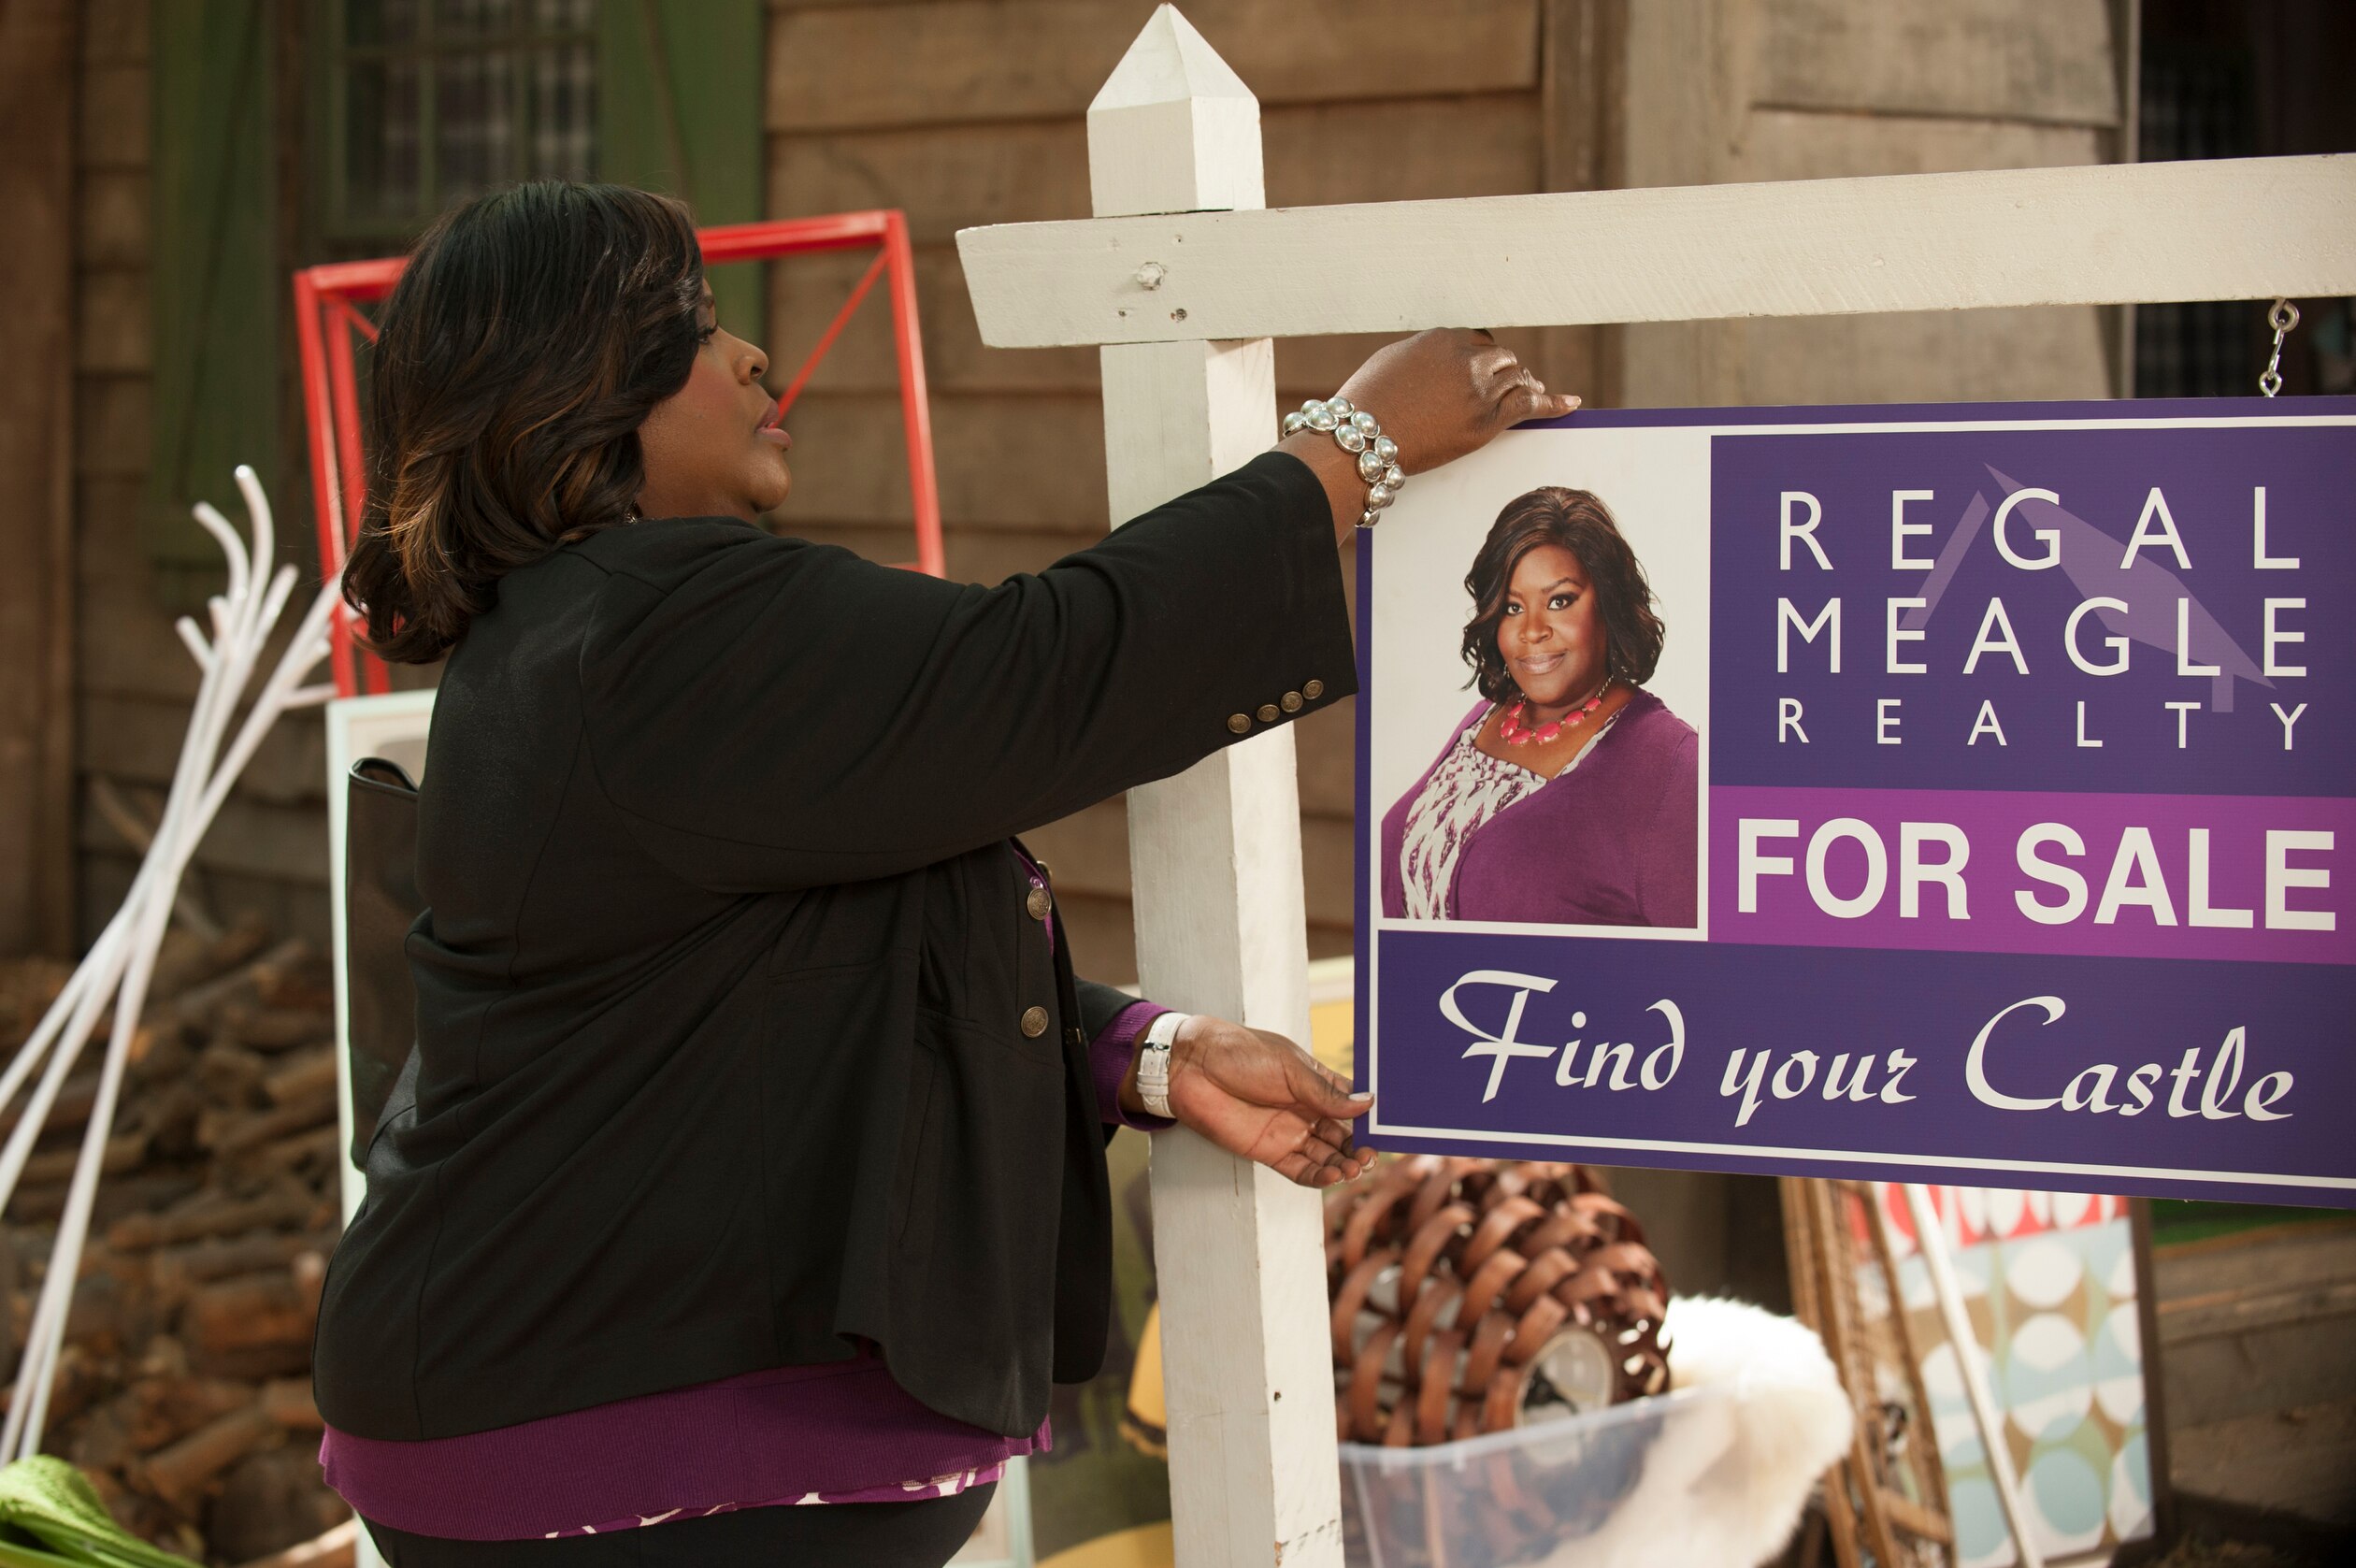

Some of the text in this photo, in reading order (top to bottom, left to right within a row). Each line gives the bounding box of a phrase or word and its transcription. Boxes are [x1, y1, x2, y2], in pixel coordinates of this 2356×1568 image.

[1780, 486, 2300, 570] REGAL
[1777, 596, 2307, 677] MEAGLE
[1778, 698, 2308, 751] REALTY
[1738, 817, 2336, 931] FOR SALE
[1439, 970, 2293, 1128] Find your Castle
